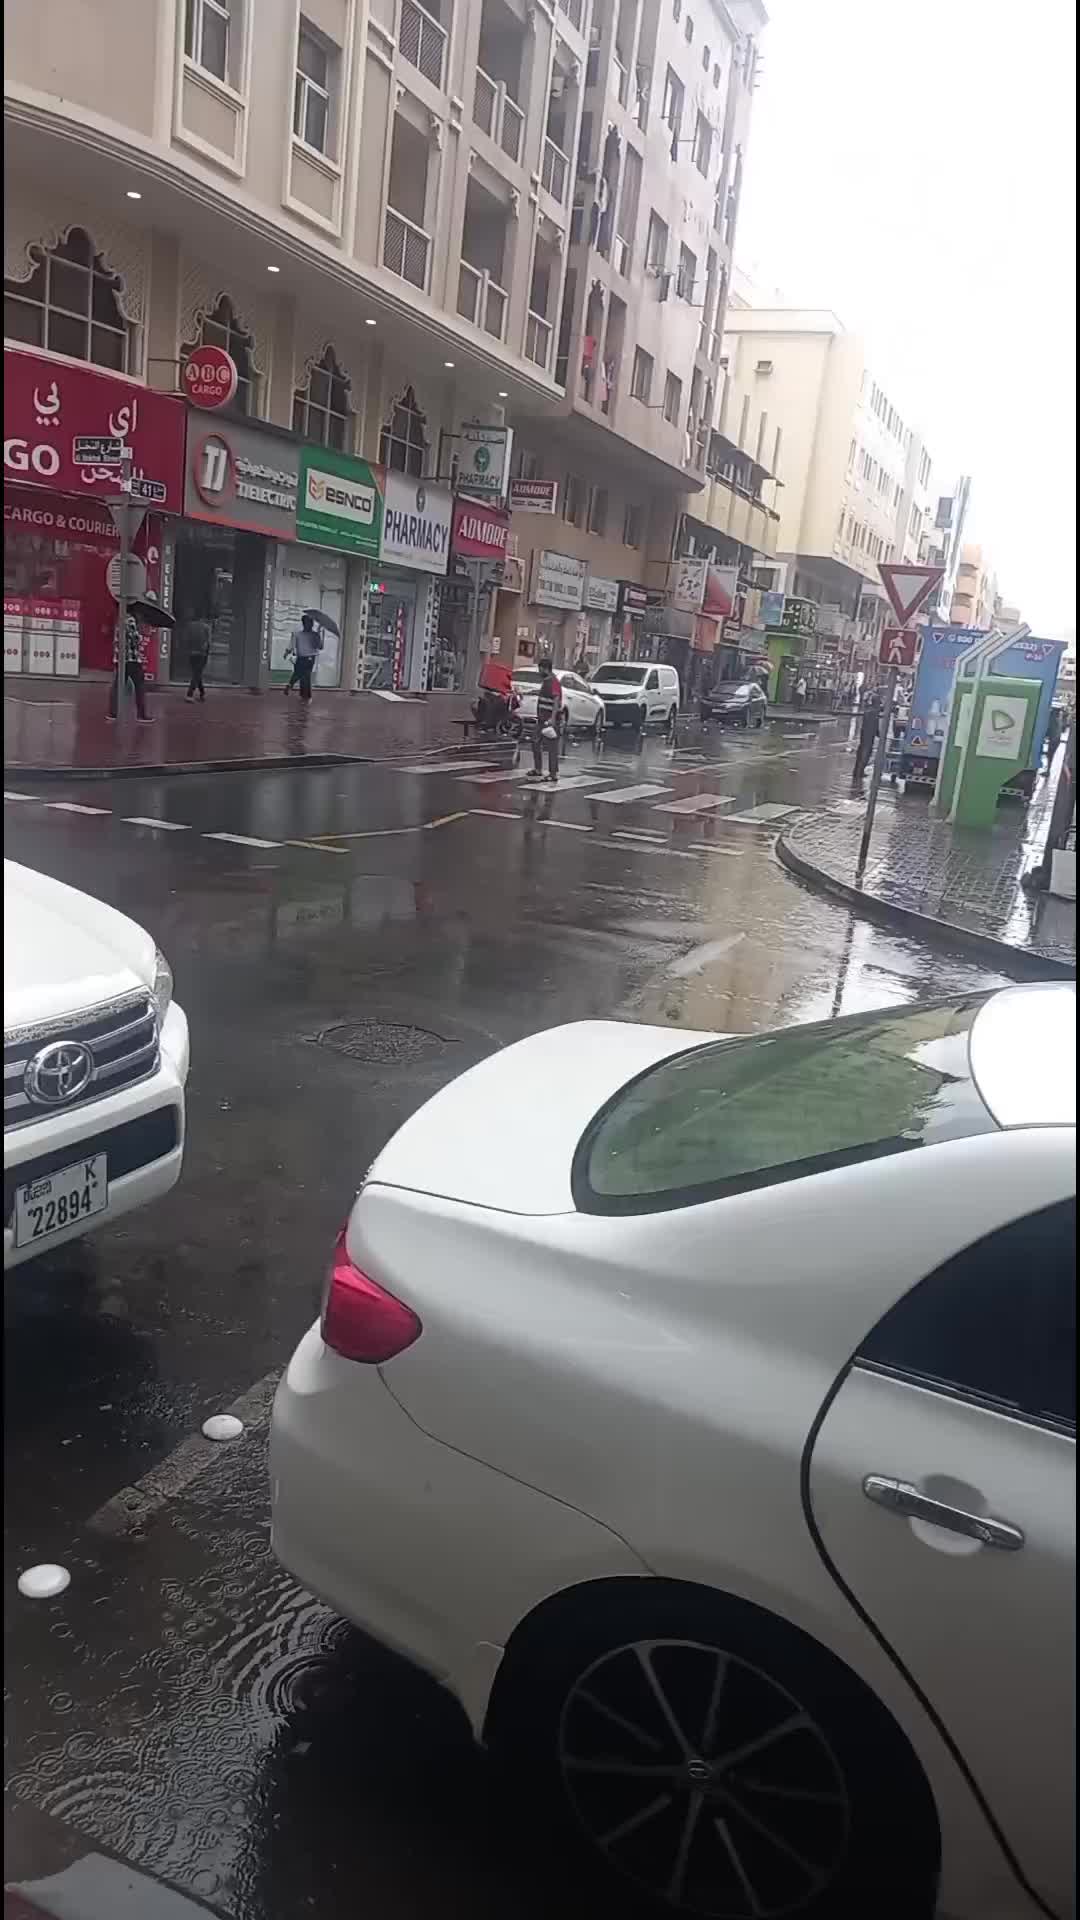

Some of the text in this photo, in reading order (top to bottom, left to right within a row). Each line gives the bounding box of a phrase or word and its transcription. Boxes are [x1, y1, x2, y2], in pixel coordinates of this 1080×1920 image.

[185, 363, 230, 384] ABC
[191, 384, 222, 396] CARGO
[141, 483, 153, 497] 41
[458, 471, 500, 488] PHARMACY
[4, 505, 54, 525] CARGO
[55, 514, 66, 528] &
[384, 508, 448, 553] PHARMACY
[457, 514, 508, 550] ADMORE
[84, 1159, 97, 1182] K
[32, 1185, 92, 1237] 22894
